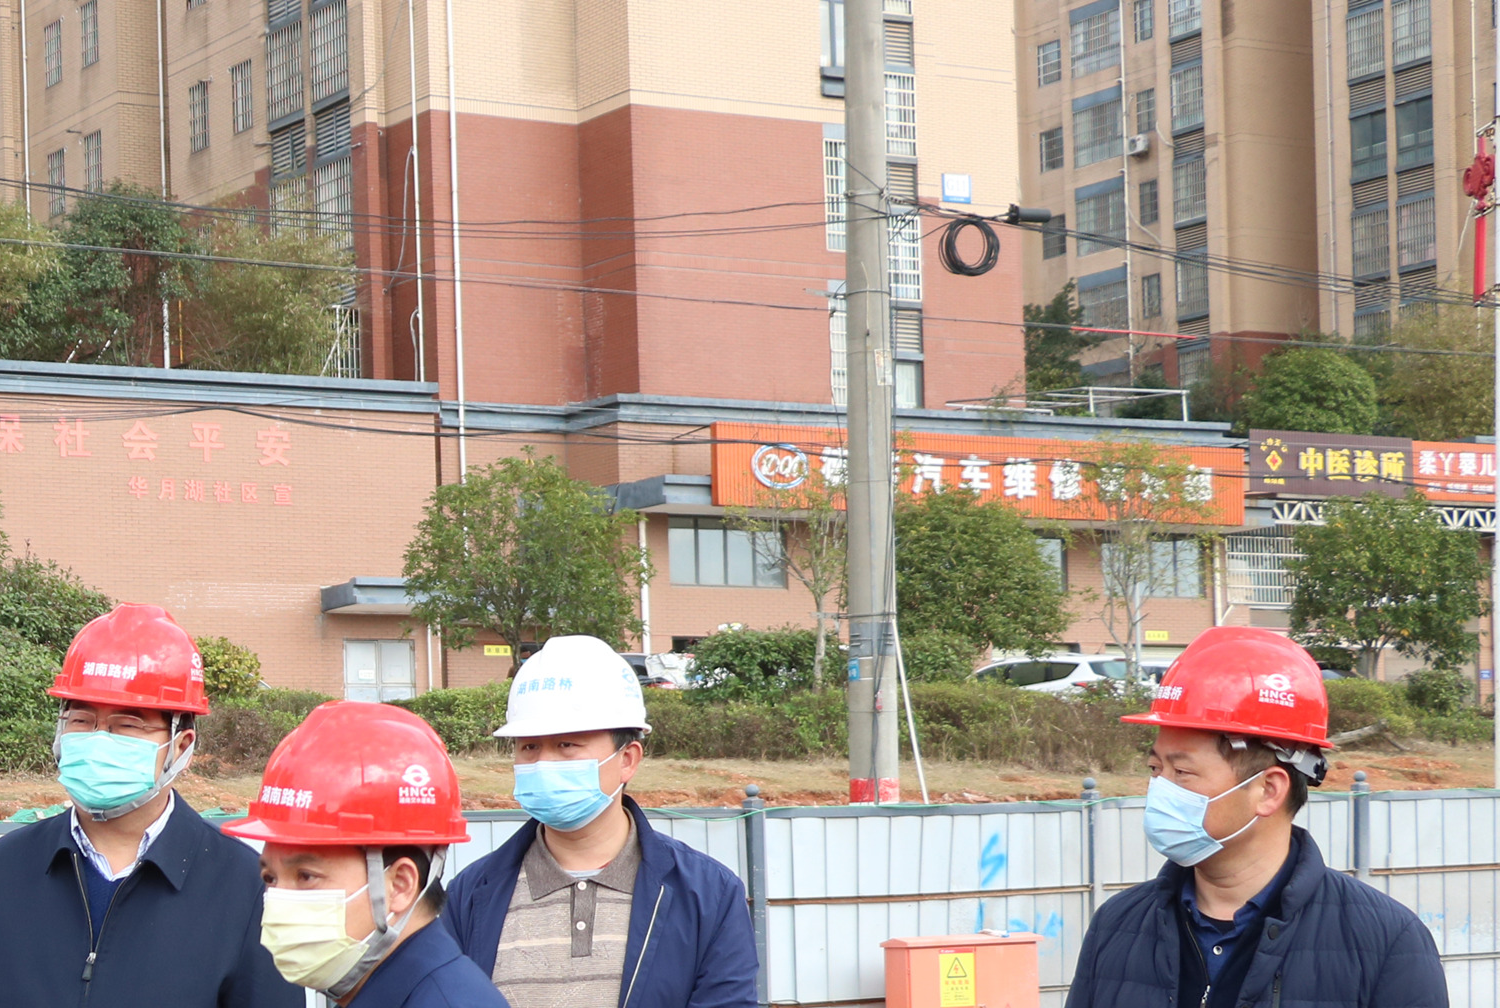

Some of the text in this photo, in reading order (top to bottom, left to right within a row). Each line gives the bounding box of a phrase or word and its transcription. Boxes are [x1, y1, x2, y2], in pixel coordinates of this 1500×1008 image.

[1299, 447, 1406, 483] 中医诊所
[82, 661, 137, 681] 湖南路桥
[516, 677, 573, 696] 湖南路桥
[1259, 688, 1296, 702] HNCC
[260, 785, 313, 809] 湖南路桥
[399, 787, 436, 798] HNCC
